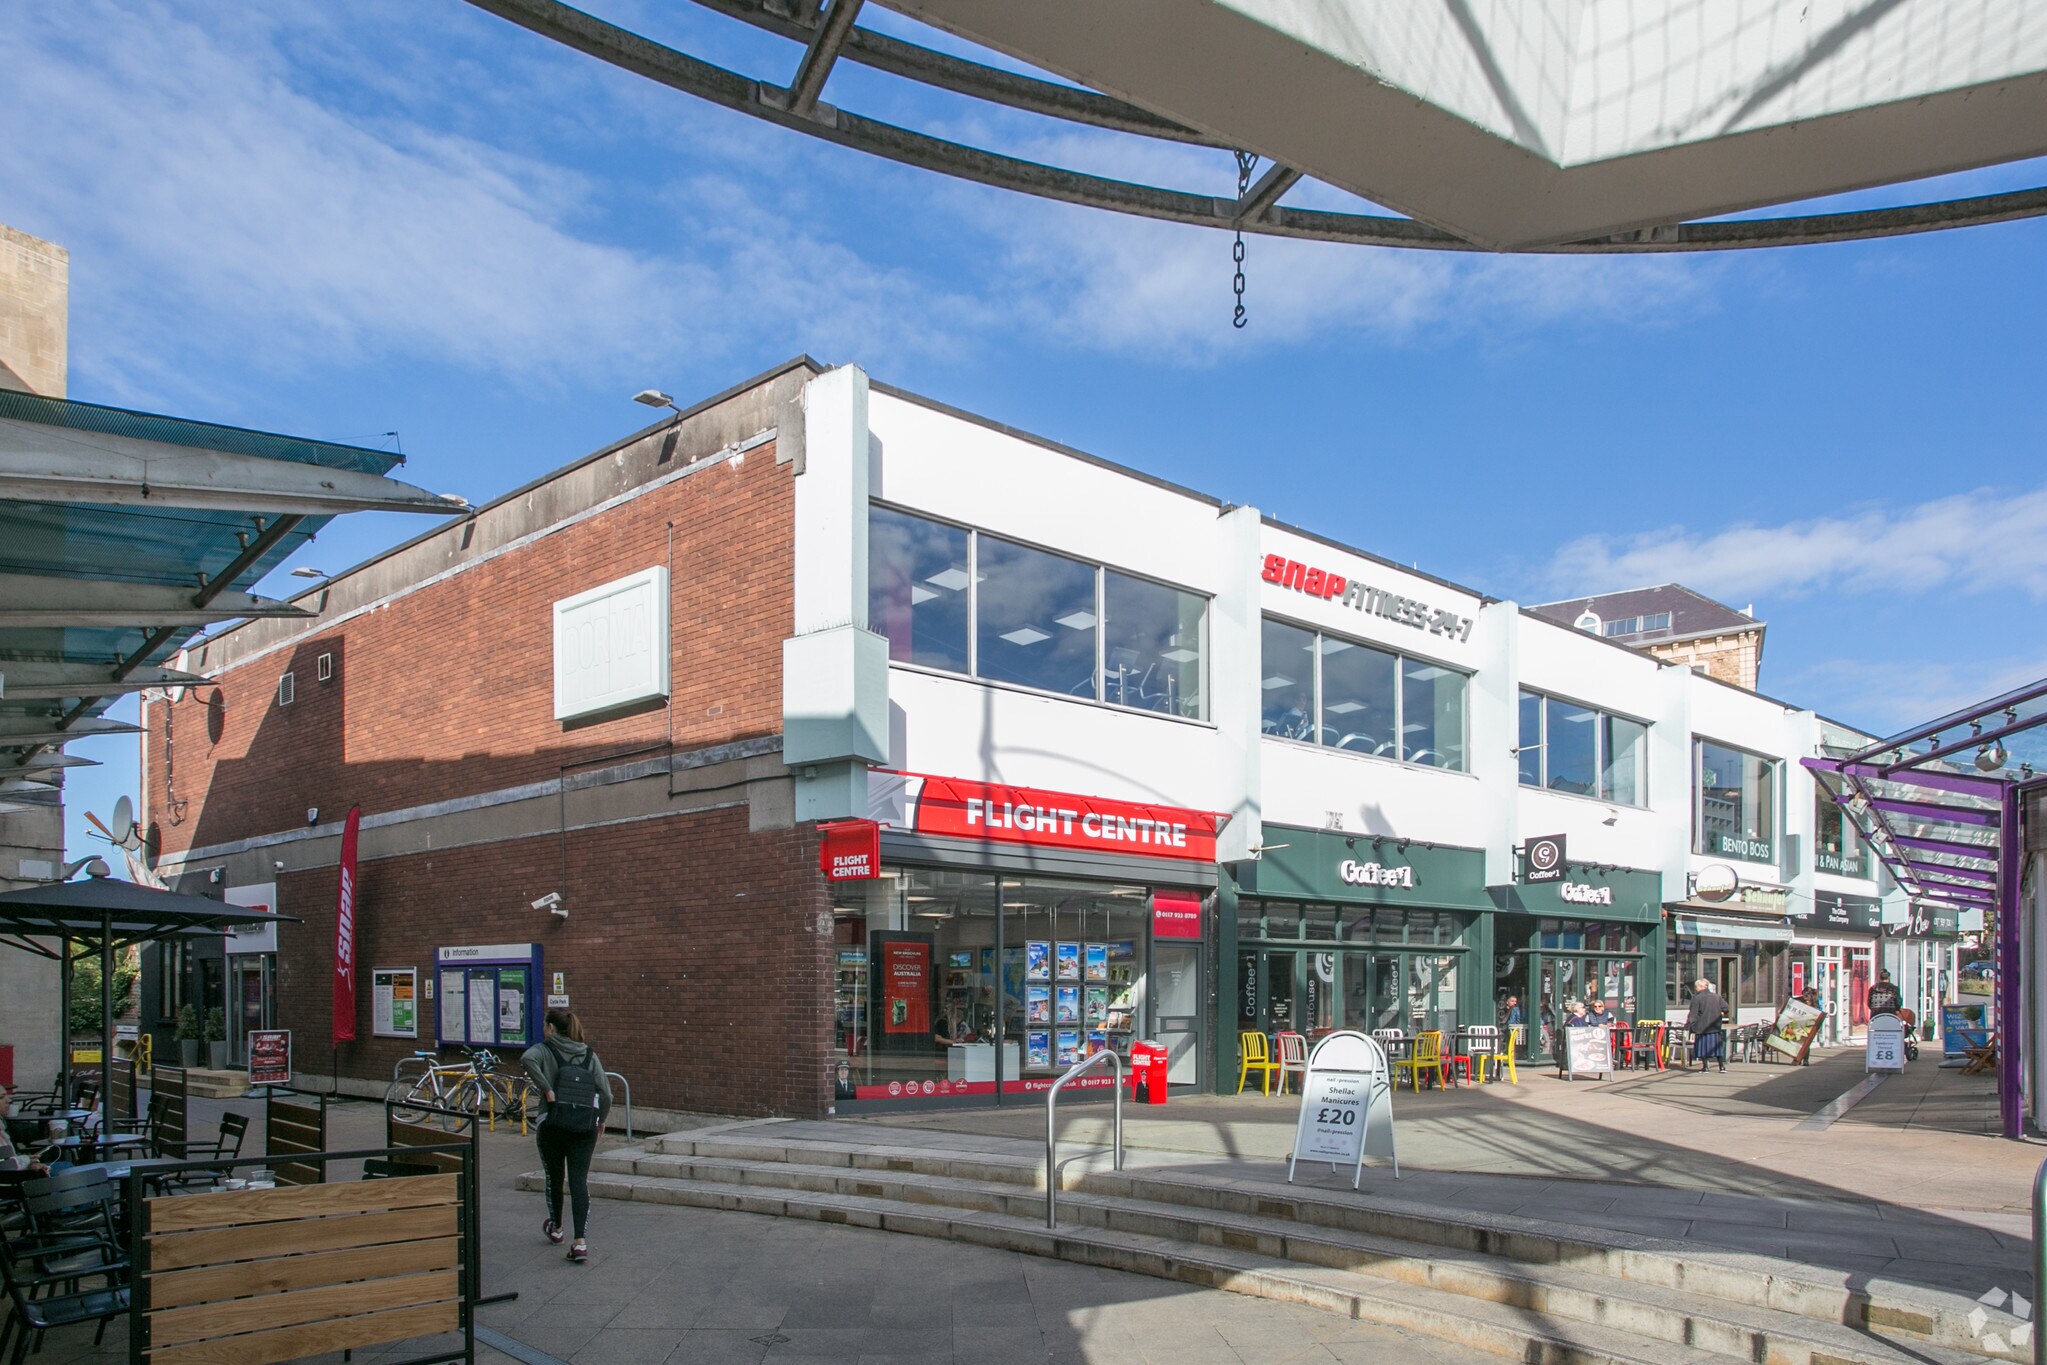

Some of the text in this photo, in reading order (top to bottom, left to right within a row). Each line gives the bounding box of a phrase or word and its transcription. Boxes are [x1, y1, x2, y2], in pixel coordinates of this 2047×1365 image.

[967, 797, 1187, 848] FLIGHT CENTRE
[1722, 836, 1769, 859] BENTO BOSS
[833, 854, 868, 867] FLIGHT
[1819, 855, 1825, 867] &
[1825, 855, 1839, 870] PAN
[1840, 859, 1858, 872] ASIAN
[832, 865, 871, 878] CENTRE
[451, 947, 479, 957] Information
[1875, 1050, 1894, 1061] £8
[1328, 1086, 1356, 1096] Shellac
[1321, 1096, 1360, 1106] Manicures
[1316, 1108, 1356, 1126] £20
